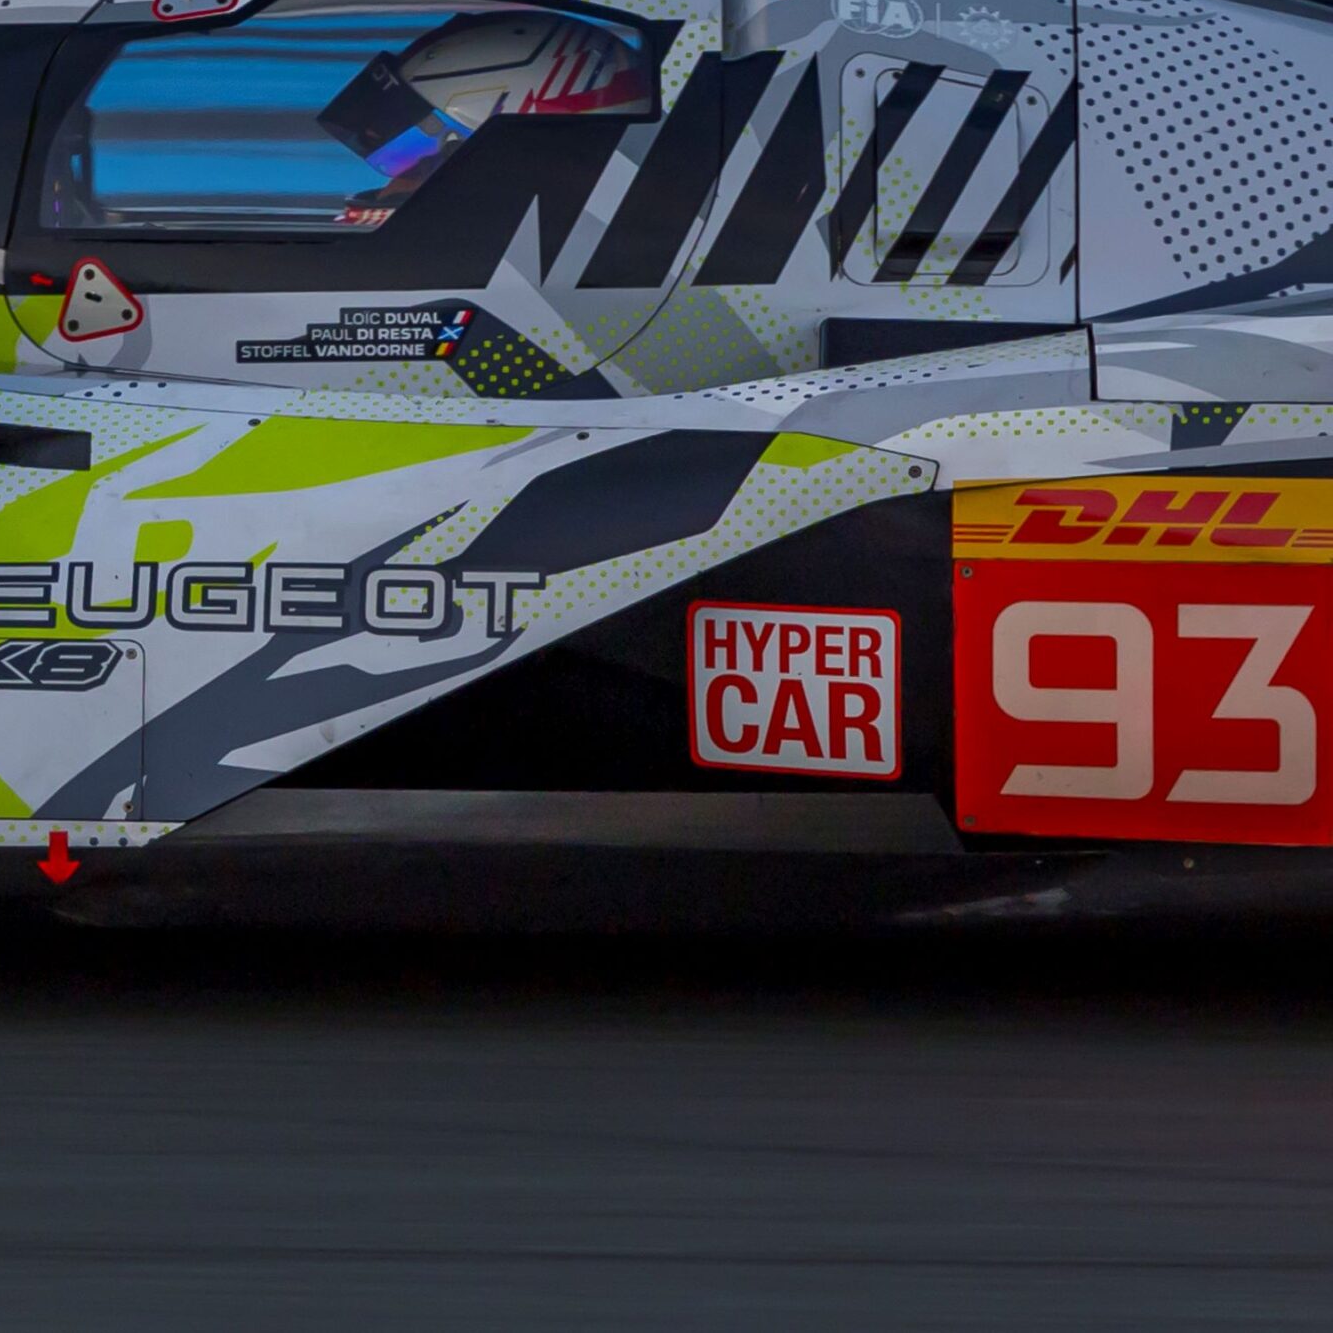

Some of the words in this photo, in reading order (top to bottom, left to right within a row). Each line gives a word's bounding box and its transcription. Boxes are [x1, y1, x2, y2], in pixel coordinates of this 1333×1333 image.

[311, 329, 352, 341] PAUL
[357, 328, 374, 340] DI
[378, 327, 433, 340] RESTA
[385, 312, 442, 325] DUVAL
[241, 345, 311, 358] STOFFEL
[316, 343, 425, 357] VANDOORNE
[1009, 489, 1296, 548] DHL
[704, 619, 883, 679] HYPER
[705, 674, 886, 763] CAR
[992, 601, 1317, 805] 93
